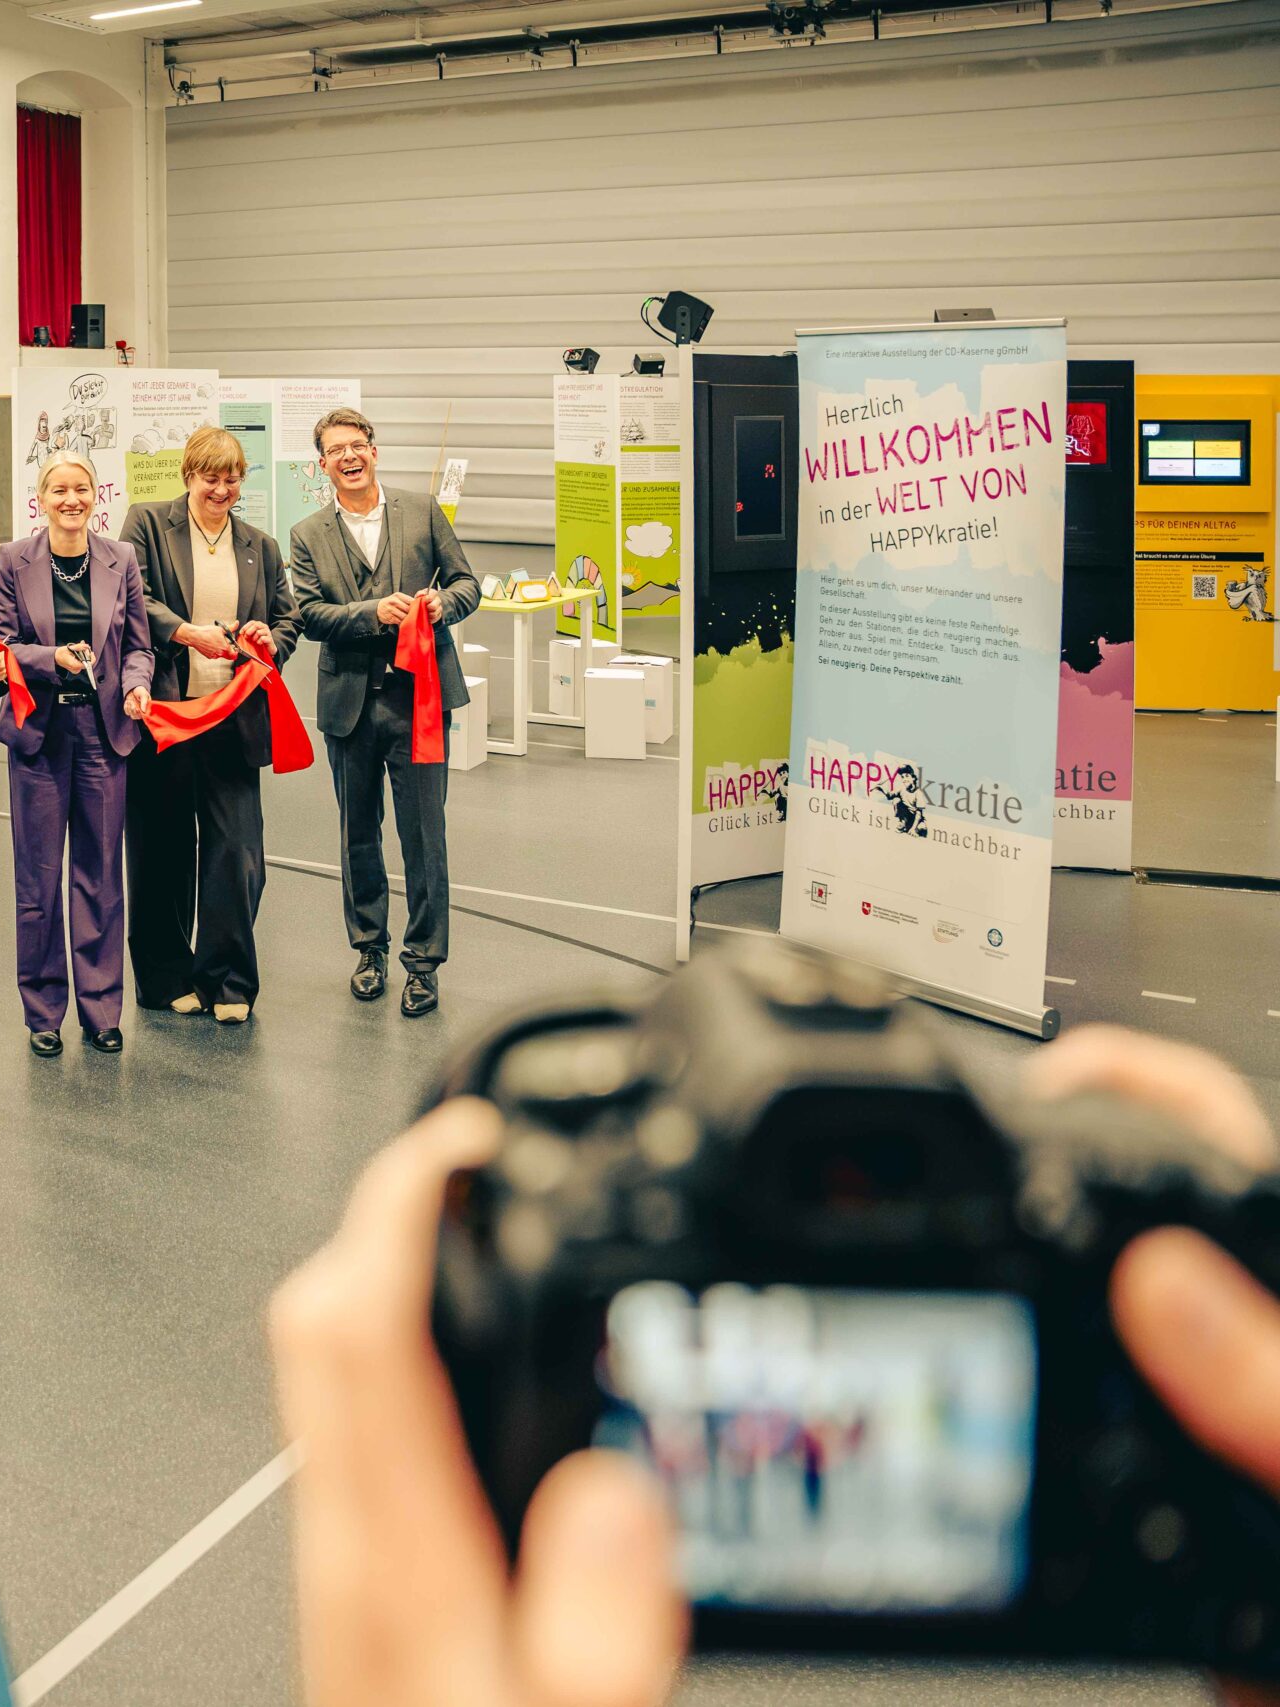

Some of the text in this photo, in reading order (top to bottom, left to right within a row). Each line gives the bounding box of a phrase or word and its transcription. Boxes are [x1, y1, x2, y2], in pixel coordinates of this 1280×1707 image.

[826, 346, 1028, 359] Eine interaktive Ausstellung der CD-Kaserne gGmbH
[826, 394, 904, 427] Herzlich
[805, 401, 1052, 484] WILLKOMMEN
[133, 460, 144, 469] WAS
[146, 460, 153, 469] DU
[154, 459, 168, 468] ÜBER
[134, 472, 163, 482] VERÄNDERT
[134, 485, 157, 495] GLAUBST
[819, 463, 1027, 525] in der WELT VON
[870, 516, 998, 553] HAPPYkratie!
[1148, 520, 1164, 528] FÜR
[1168, 520, 1200, 529] DEINEN
[1204, 521, 1237, 530] ALLTAG
[820, 575, 836, 584] Hier
[838, 577, 854, 587] geht
[856, 580, 864, 588] es
[901, 585, 923, 593] unser
[926, 586, 974, 598] Miteinander
[976, 592, 990, 600] und
[994, 594, 1022, 604] unsere
[820, 604, 826, 612] In
[828, 604, 850, 614] dieser
[852, 608, 896, 622] Ausstellung
[898, 614, 912, 623] gibt
[926, 616, 946, 626] keine
[949, 619, 968, 629] feste
[970, 621, 1021, 636] Reihenfolge.
[820, 615, 833, 624] Geh
[848, 620, 862, 628] den
[908, 626, 918, 636] die
[922, 628, 940, 638] dich
[943, 632, 981, 646] neugierig
[820, 626, 846, 638] Probier
[867, 634, 886, 644] Spiel
[950, 644, 978, 656] Tausch
[982, 649, 999, 659] dich
[842, 644, 852, 652] zu
[853, 646, 872, 654] zweit
[874, 648, 892, 656] oder
[818, 656, 830, 664] Sei
[870, 663, 892, 674] Deine
[894, 666, 940, 681] Perspektive
[710, 767, 780, 812] HAPPY
[811, 756, 1022, 824] HAPPY kratie
[1055, 762, 1117, 792] atie
[708, 812, 773, 833] Glück ist
[1054, 804, 1117, 820] chbar
[808, 796, 1022, 860] Glück ist machbar
